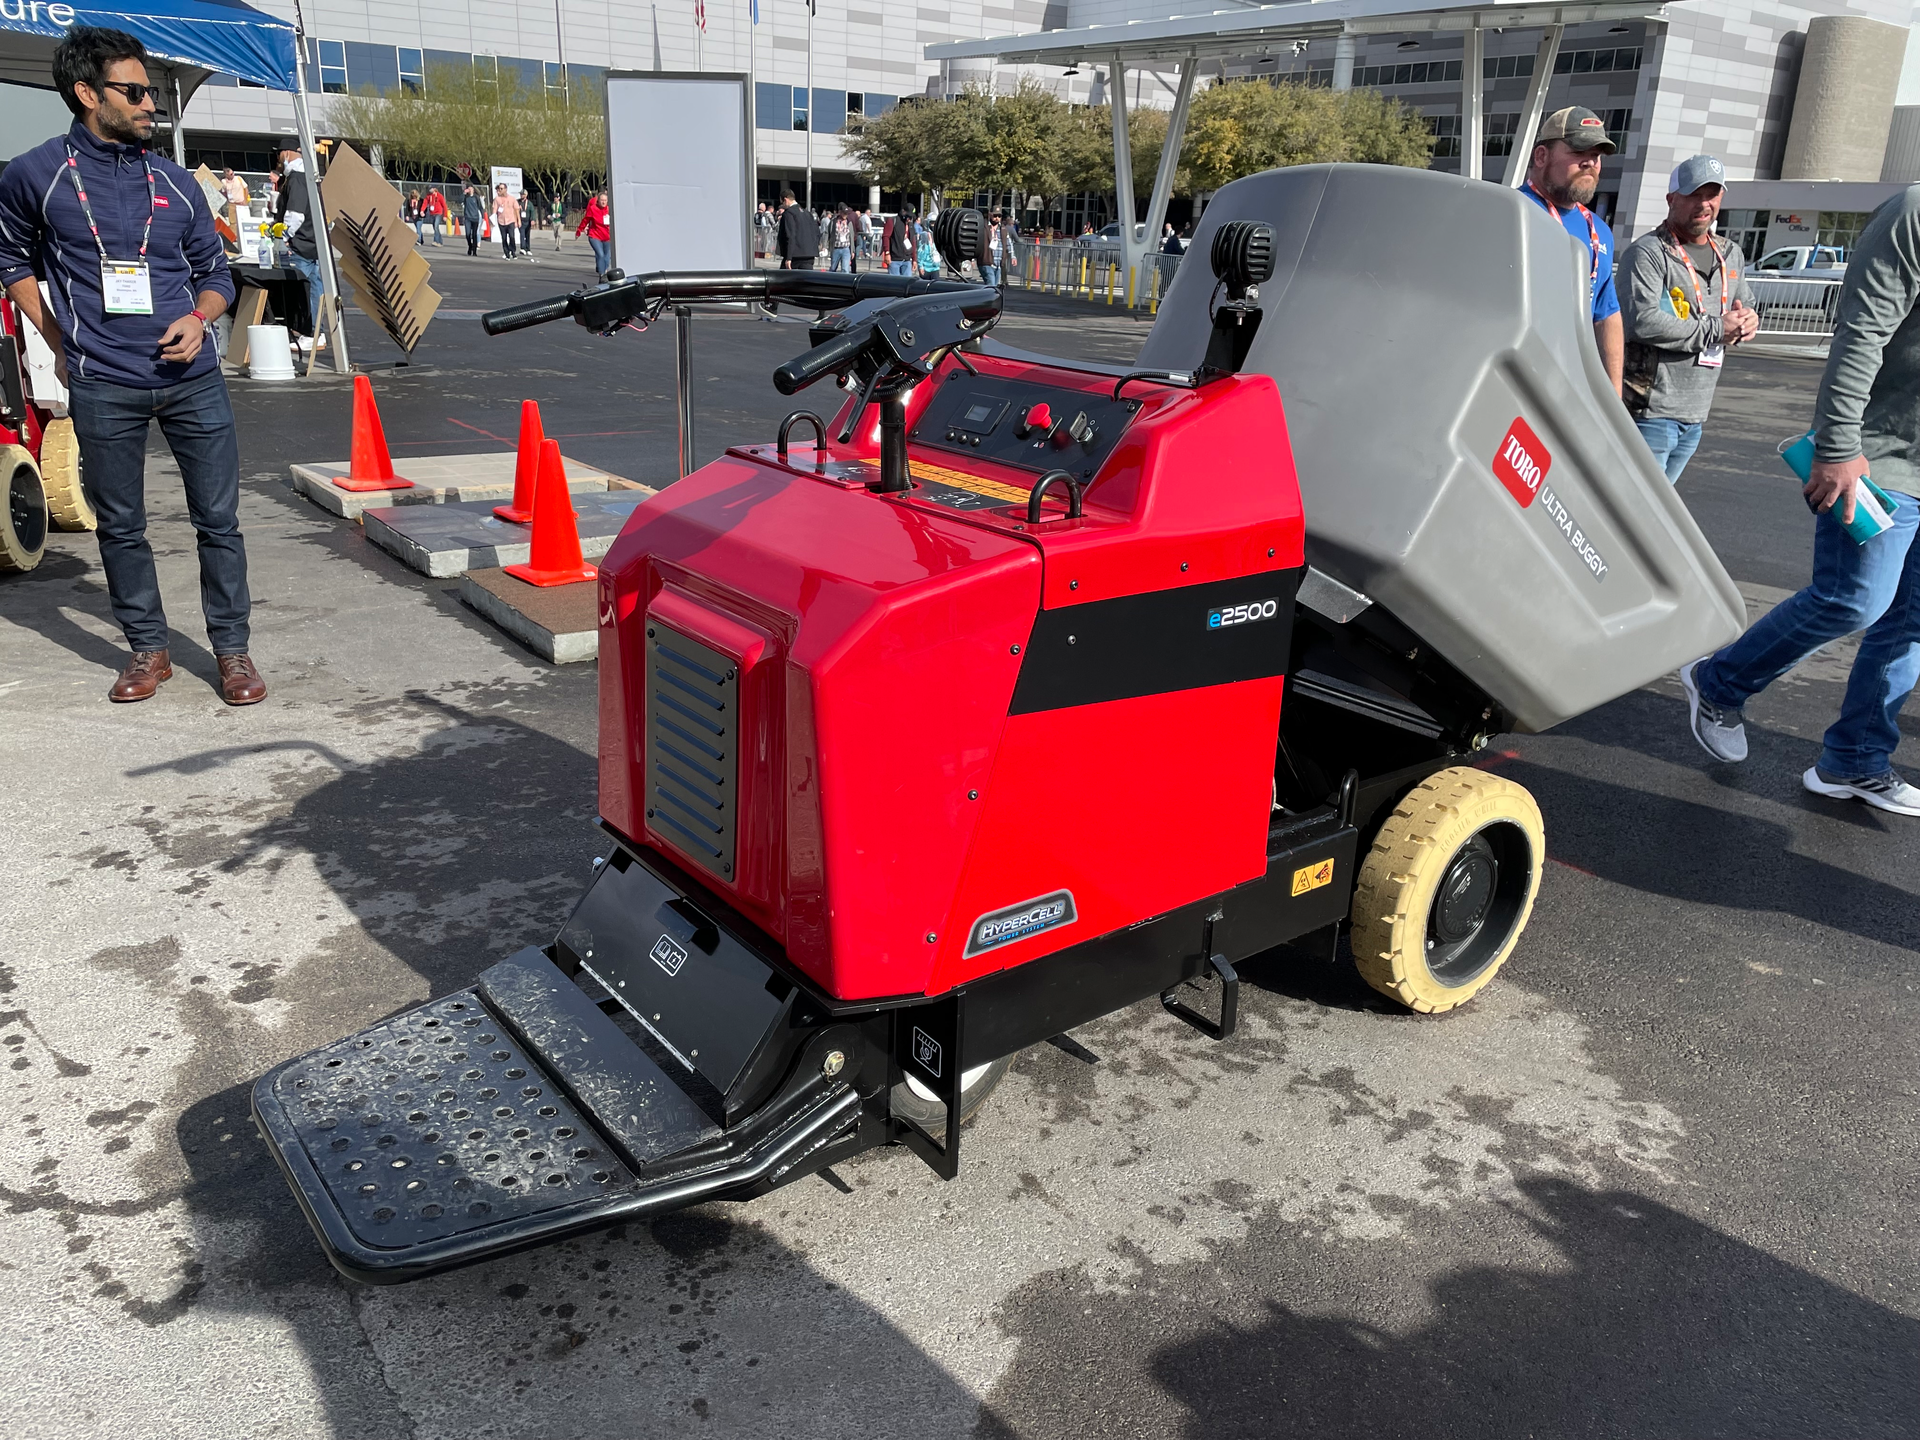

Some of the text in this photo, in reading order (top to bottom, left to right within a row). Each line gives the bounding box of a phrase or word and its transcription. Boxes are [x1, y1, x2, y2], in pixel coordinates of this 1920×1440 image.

[1775, 214, 1802, 224] FedEx
[1788, 224, 1810, 232] Office
[1503, 434, 1541, 489] TORO
[1541, 486, 1607, 576] ULTRA BUGGY
[1209, 600, 1277, 628] e2500
[998, 922, 1045, 942] POWER SYSTEM
